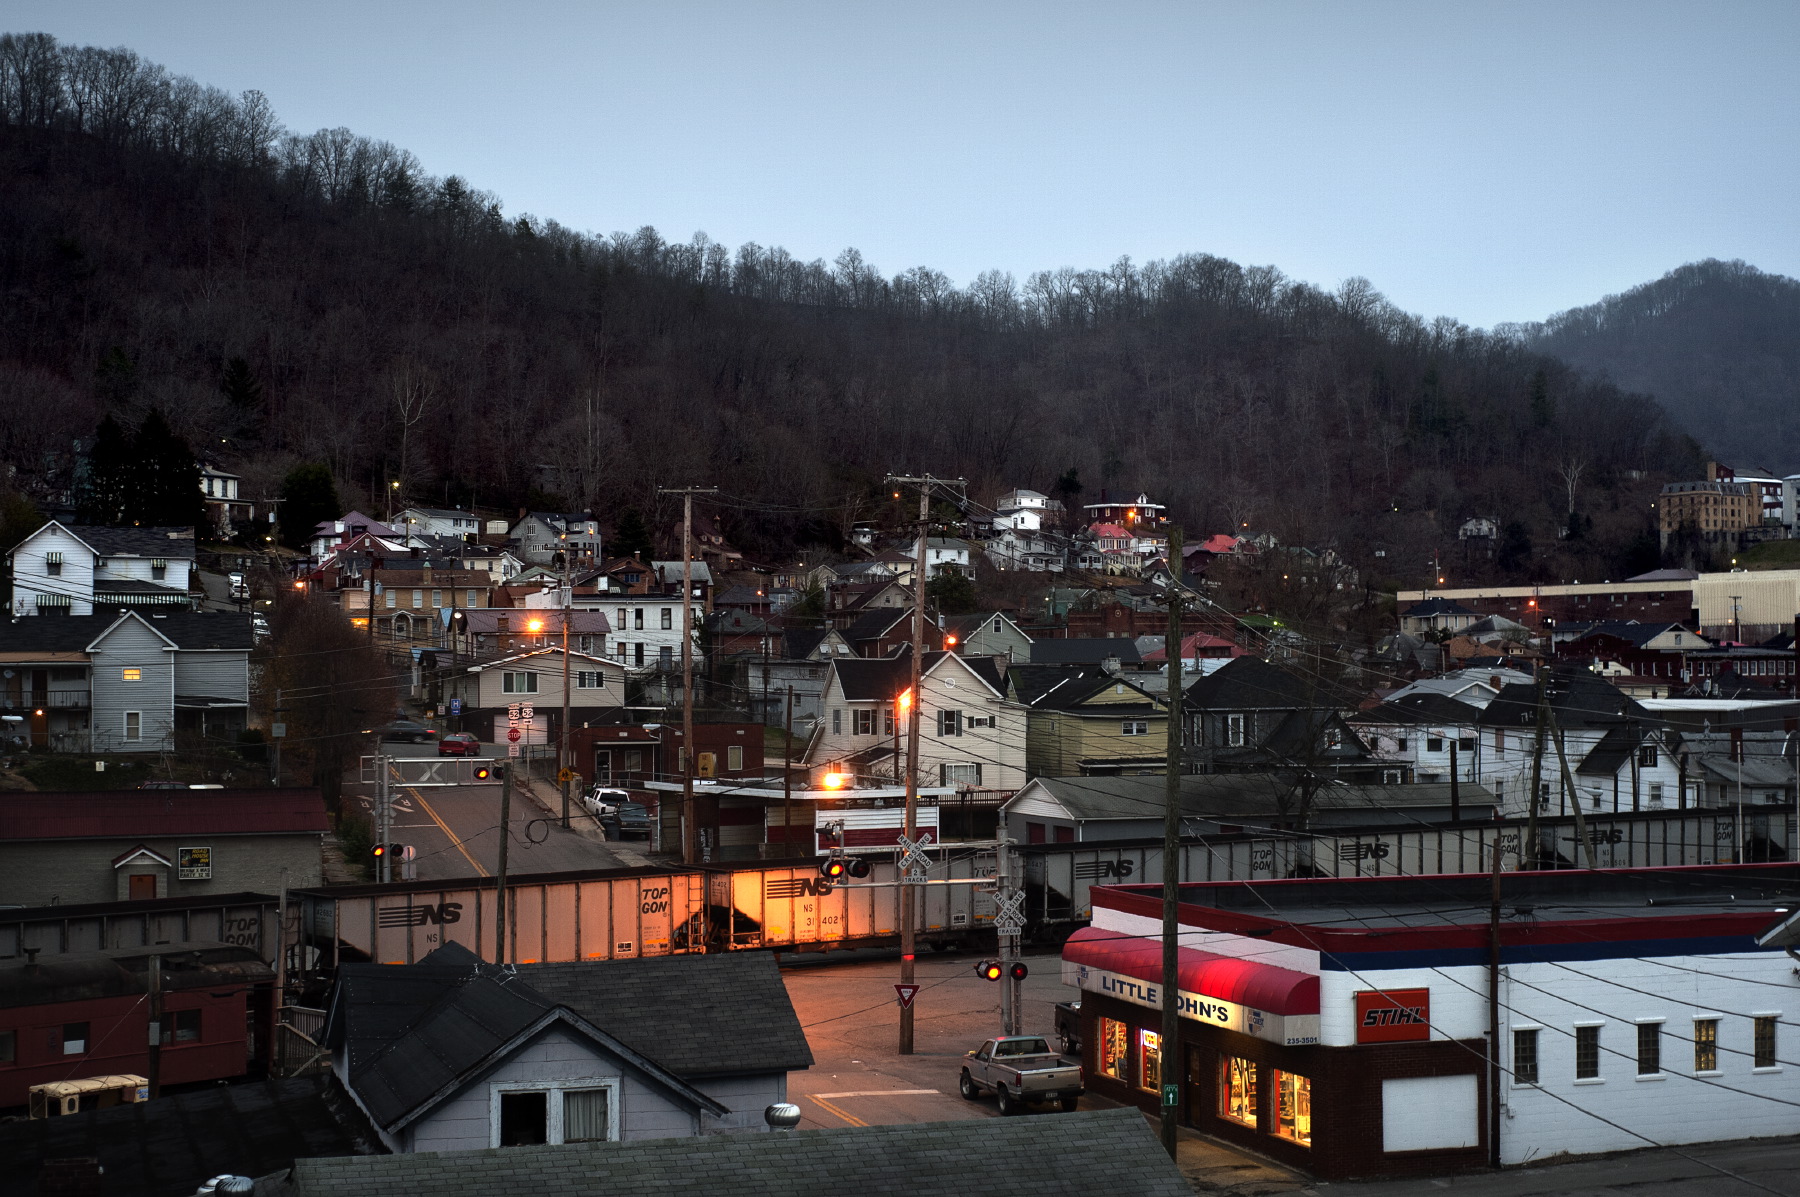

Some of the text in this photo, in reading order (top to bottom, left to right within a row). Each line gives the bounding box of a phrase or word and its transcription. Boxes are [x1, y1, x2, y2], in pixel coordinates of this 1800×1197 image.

[453, 700, 459, 708] H
[523, 709, 532, 717] 52
[1717, 822, 1733, 831] TOP
[1501, 834, 1518, 843] TOP
[1716, 831, 1733, 841] GON
[898, 835, 931, 867] RAIL ROAD
[900, 835, 930, 868] CROSSING
[1253, 850, 1273, 860] TOP
[1104, 860, 1134, 878] NS
[1253, 860, 1272, 871] GON
[642, 887, 669, 900] TOP
[800, 877, 832, 897] NS
[420, 902, 463, 926] NS
[641, 901, 669, 914] GON
[803, 904, 813, 913] NS
[993, 893, 1006, 908] RAIL
[1011, 910, 1025, 925] ROAD
[995, 893, 1024, 925] CROSSING
[225, 918, 258, 932] TOP
[225, 933, 257, 946] GON
[426, 934, 438, 943] NS
[1102, 975, 1229, 1022] LITTLE OHN'S
[1362, 1006, 1426, 1027] STIHL
[1287, 1037, 1318, 1045] 235-3501
